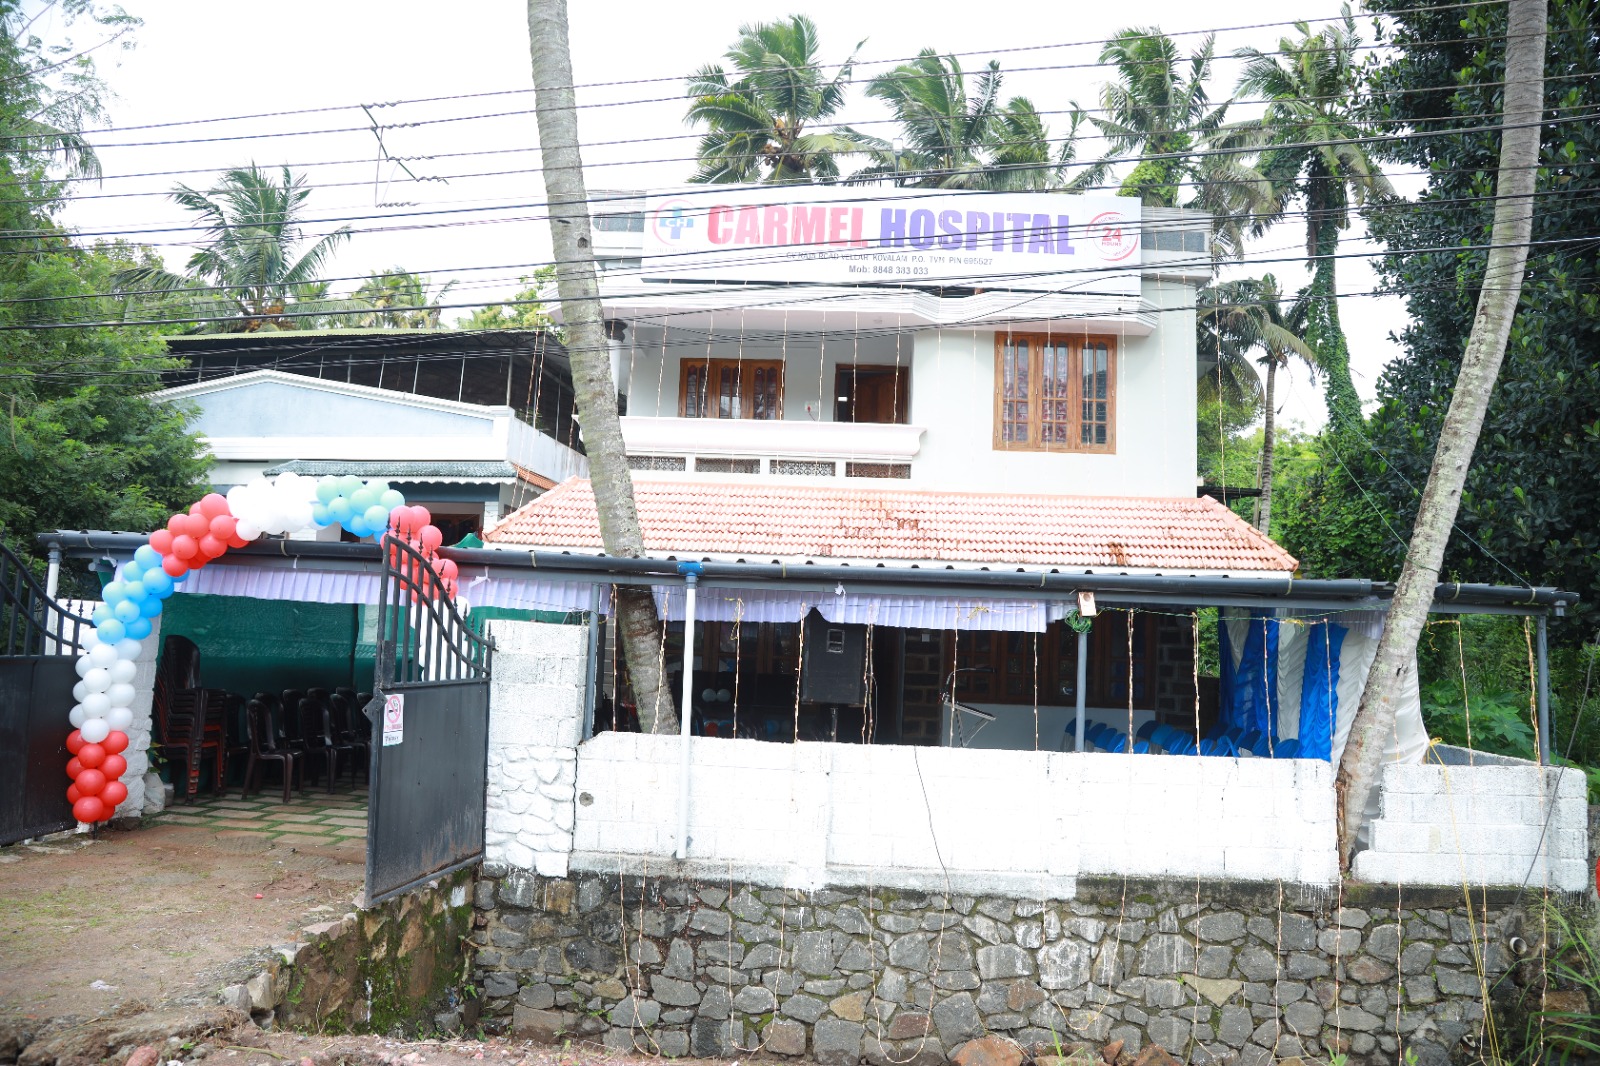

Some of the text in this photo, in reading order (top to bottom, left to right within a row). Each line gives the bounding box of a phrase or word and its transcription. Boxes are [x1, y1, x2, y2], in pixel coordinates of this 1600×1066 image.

[707, 204, 1075, 255] CARMEL HOSPITAL
[1102, 226, 1122, 242] 24
[949, 256, 962, 264] PIN
[848, 265, 871, 274] Mob:
[872, 266, 893, 274] 8848
[913, 266, 929, 275] 033
